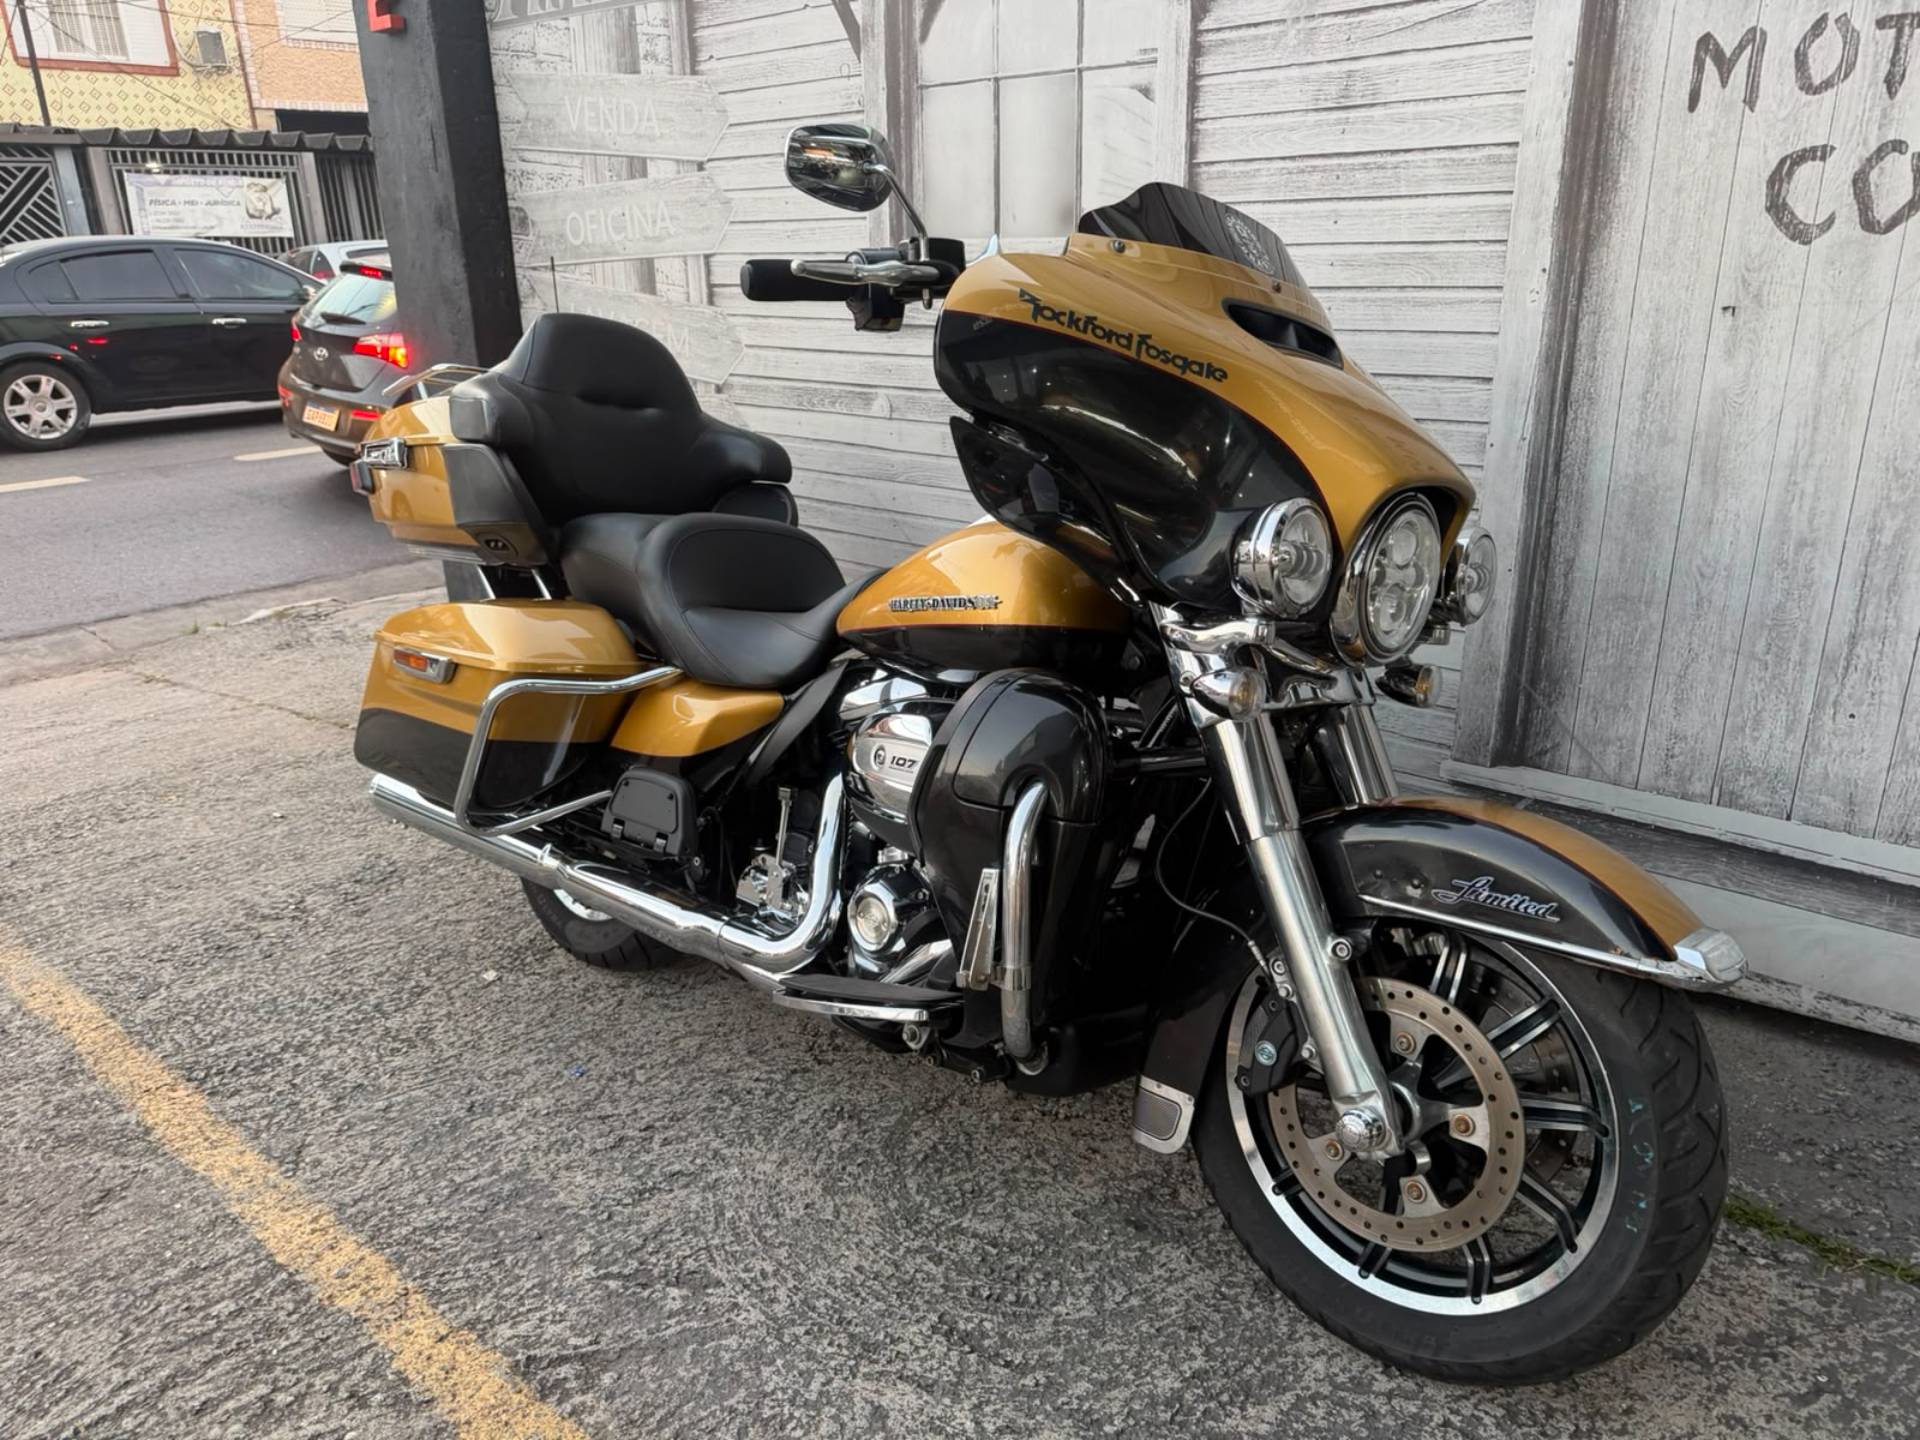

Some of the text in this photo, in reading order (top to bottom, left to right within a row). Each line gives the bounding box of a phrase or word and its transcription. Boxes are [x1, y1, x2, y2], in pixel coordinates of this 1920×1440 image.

[1688, 13, 1920, 113] MOT
[564, 96, 661, 137] VENDA
[1765, 139, 1920, 245] CO
[566, 200, 676, 245] OFICINA
[1136, 334, 1228, 383] Fosgate
[889, 595, 998, 611] HARLEY-DAVIDS
[890, 756, 917, 769] 107
[1431, 876, 1560, 922] Limited
